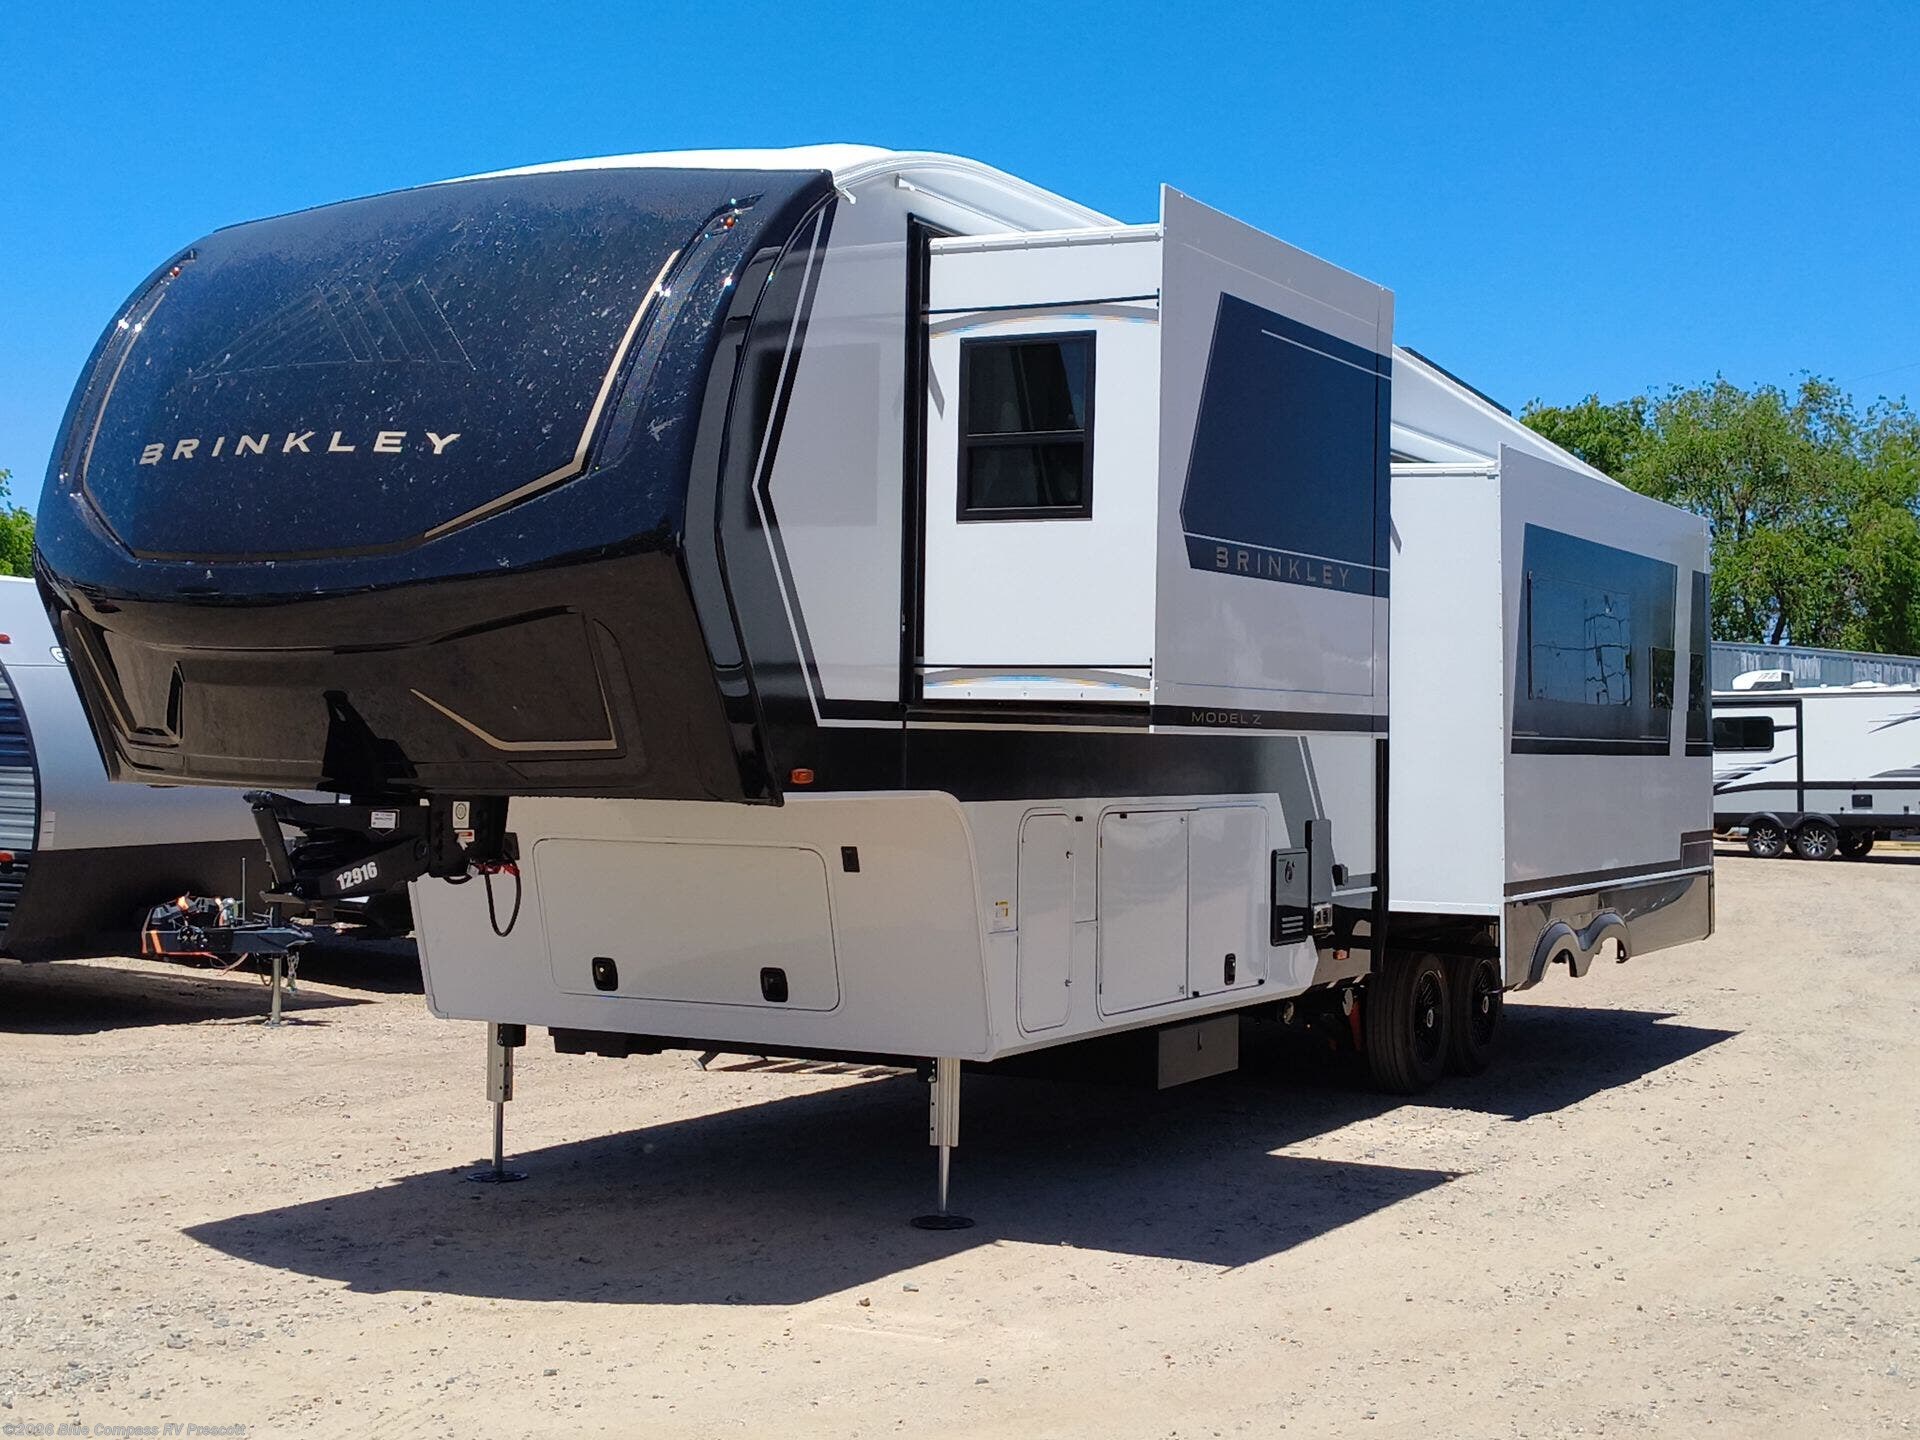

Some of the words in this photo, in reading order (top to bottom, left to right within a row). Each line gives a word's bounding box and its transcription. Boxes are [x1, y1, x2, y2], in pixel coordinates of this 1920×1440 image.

[139, 430, 461, 466] BRINKLEY
[1215, 546, 1350, 587] BRINKLEY
[1191, 711, 1248, 725] MODEL
[1252, 713, 1262, 725] Z
[336, 861, 378, 891] 12916
